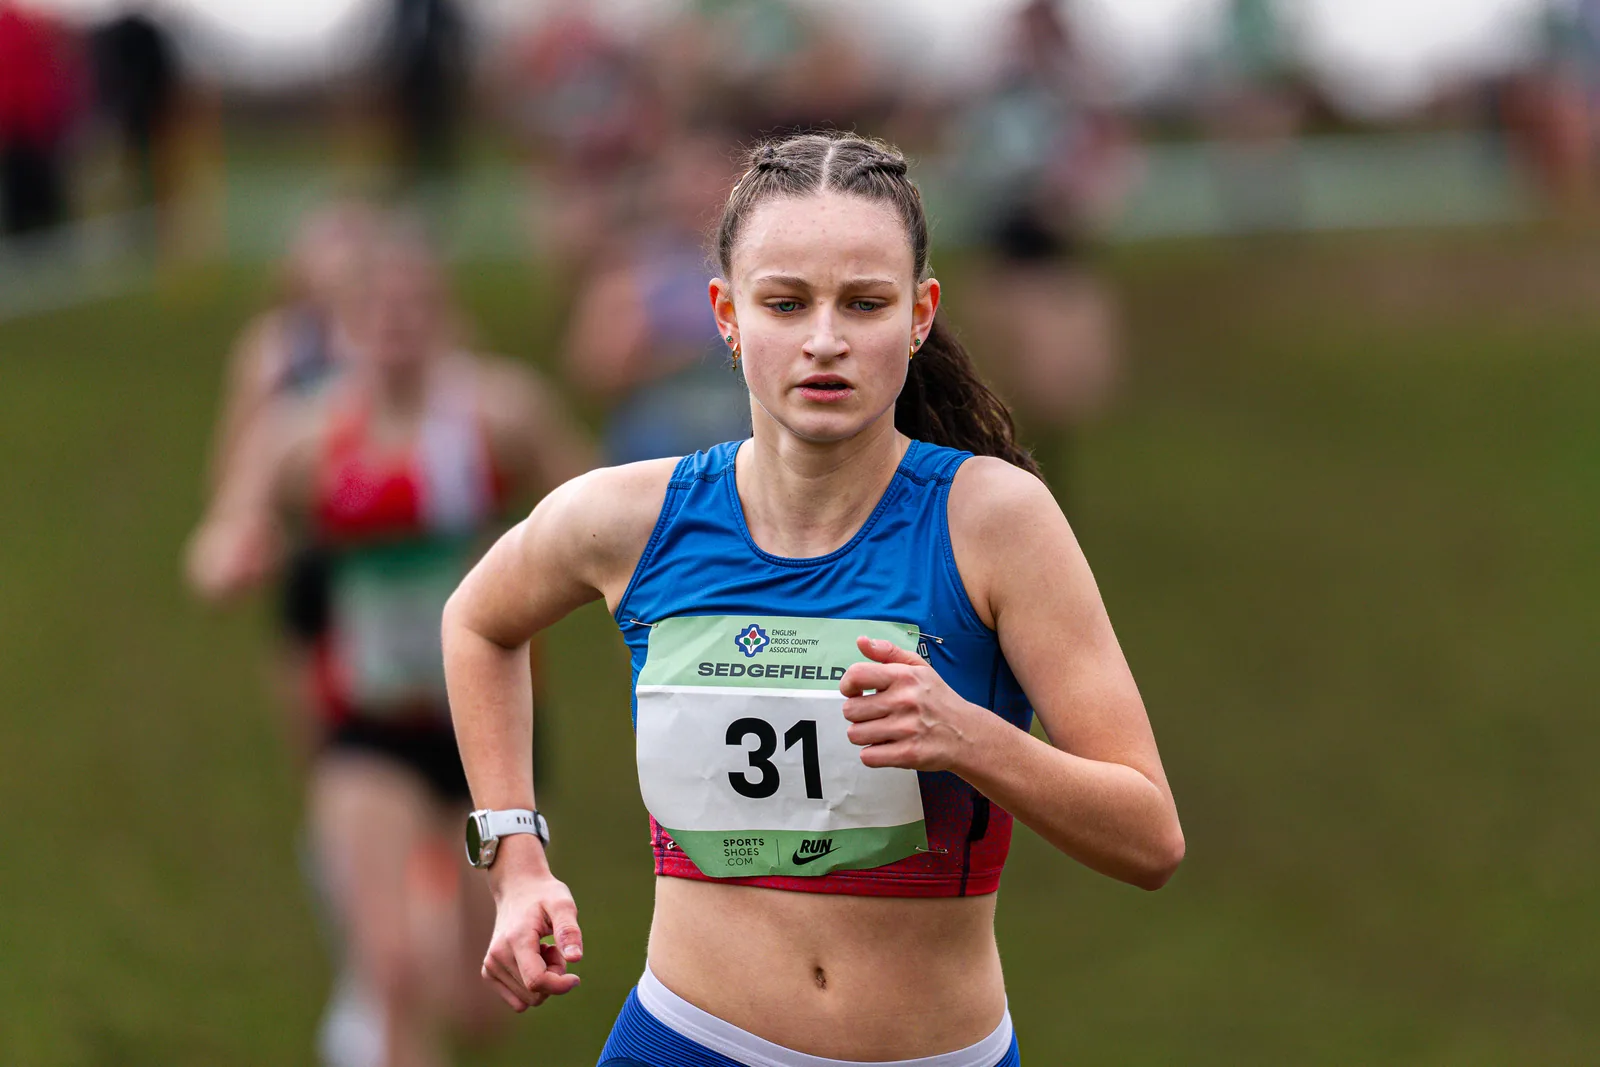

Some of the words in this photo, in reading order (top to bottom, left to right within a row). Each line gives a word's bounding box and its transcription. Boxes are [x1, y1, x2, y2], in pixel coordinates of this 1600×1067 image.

[771, 629, 797, 637] ENGLISH
[770, 637, 790, 645] CROSS
[790, 638, 820, 646] COUNTRY
[769, 646, 808, 654] ASSOCIATION
[697, 662, 847, 681] SEDGEFIELD
[725, 717, 823, 799] 31
[723, 838, 765, 847] SPORTS
[800, 839, 833, 853] RUN
[724, 847, 760, 857] SHOES
[725, 857, 753, 866] .COM
